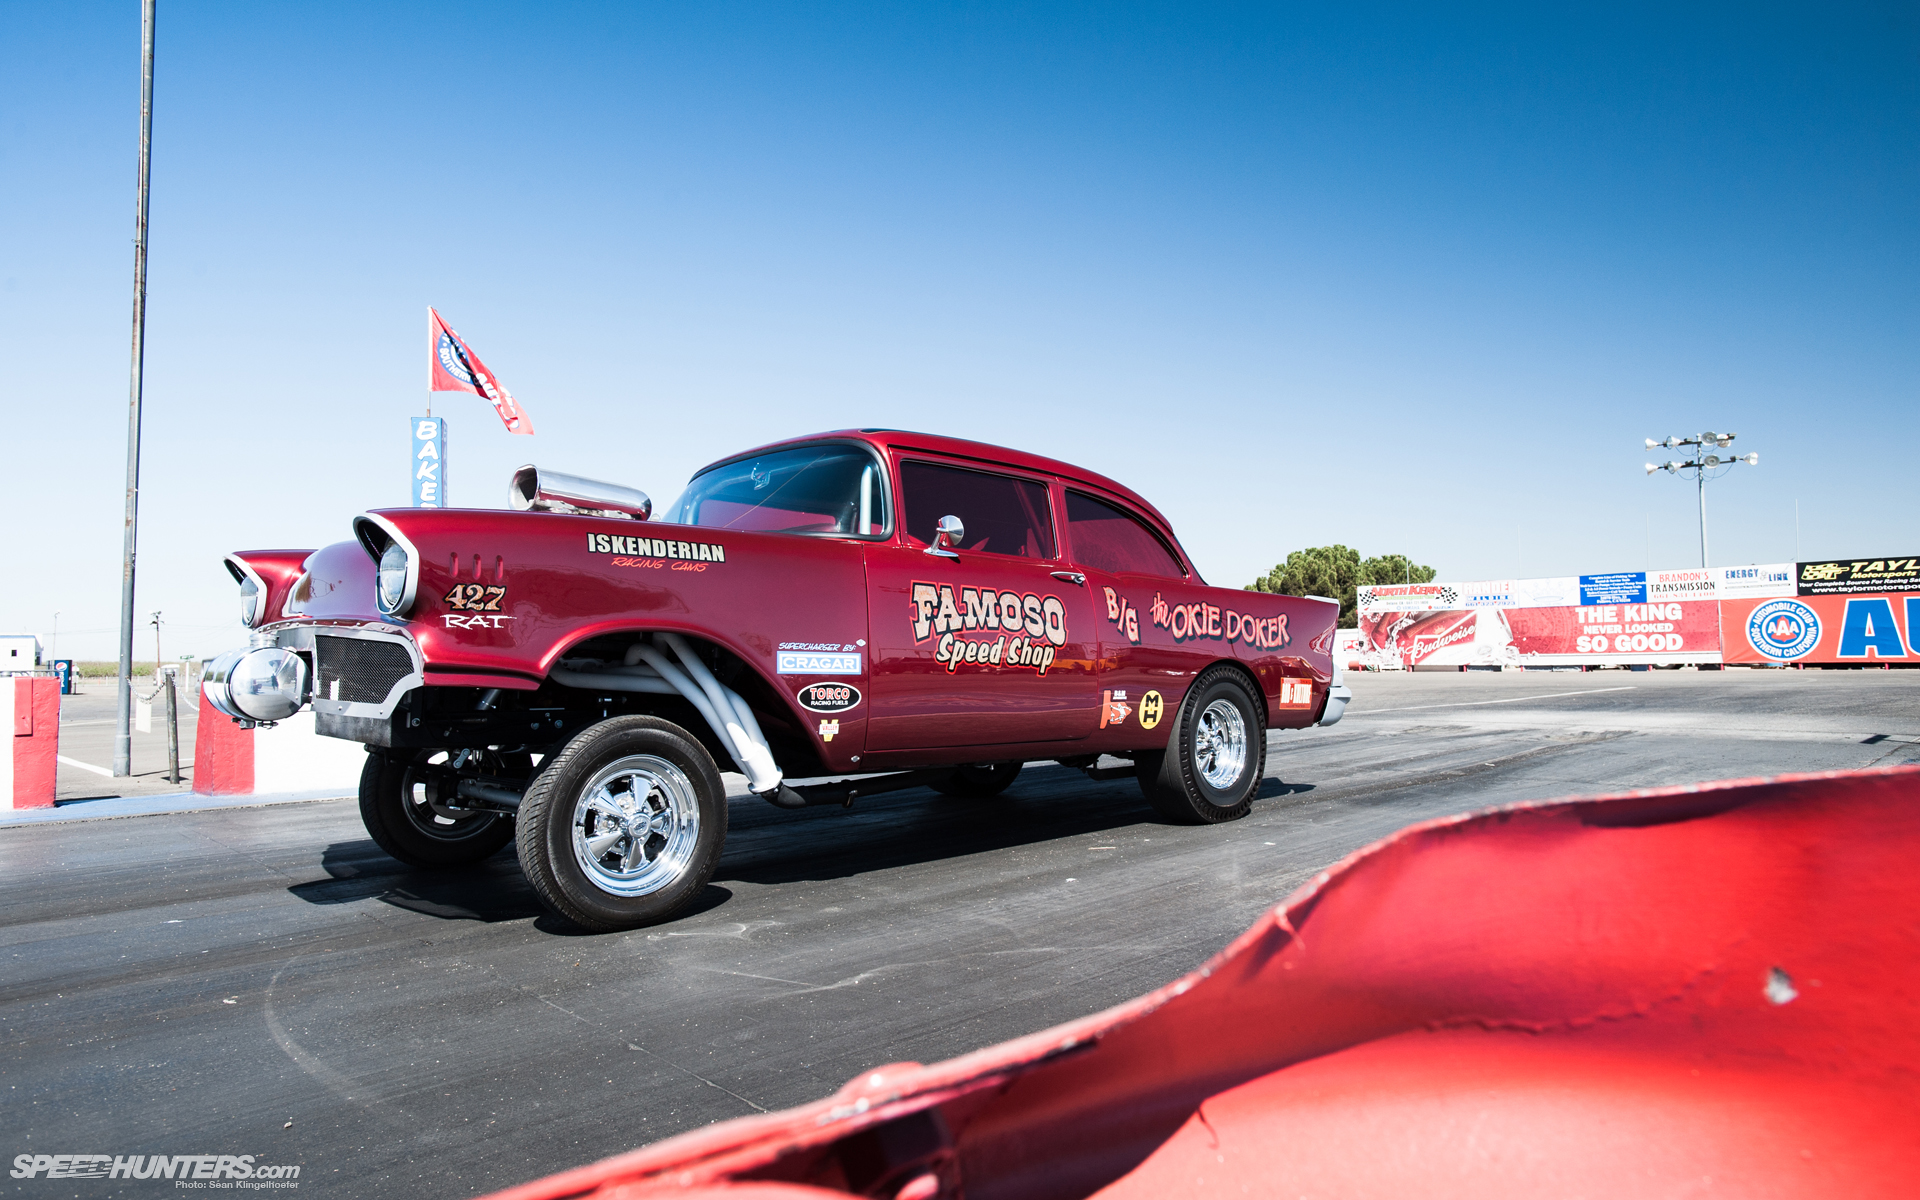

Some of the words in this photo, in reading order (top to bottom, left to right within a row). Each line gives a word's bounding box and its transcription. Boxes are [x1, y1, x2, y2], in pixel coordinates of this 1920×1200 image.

[416, 420, 439, 508] BAKE
[586, 533, 725, 562] ISKENDERIAN
[611, 556, 665, 570] RACING
[671, 560, 709, 573] CAMS
[1658, 572, 1709, 583] BRANDON'S
[1725, 569, 1759, 579] ENERGY
[1768, 572, 1789, 582] LINK
[1850, 571, 1917, 579] Motorsports
[1372, 586, 1408, 596] NORTH
[1408, 585, 1443, 595] KERN
[1650, 581, 1716, 593] TRANSMISSION
[445, 583, 507, 612] 427
[911, 582, 1067, 646] FAMOSO
[1149, 592, 1172, 628] the
[1226, 610, 1290, 648] DOKER
[1575, 606, 1618, 623] THE
[1624, 603, 1683, 622] KING
[1753, 602, 1797, 625] AUTOMOBILE
[1796, 606, 1815, 624] CLUB
[440, 614, 517, 630] RAT
[1584, 624, 1622, 634] NEVER
[1625, 622, 1674, 633] LOOKED
[1767, 620, 1799, 636] AAA
[1405, 625, 1477, 660] Budweise
[1576, 636, 1609, 652] SO
[1614, 633, 1684, 652] GOOD
[1751, 627, 1783, 657] SOUTHERN
[1783, 626, 1817, 657] CALIFORNIA
[936, 632, 1007, 673] Speed
[1006, 636, 1056, 676] Shop
[783, 657, 855, 669] CRAGAR
[809, 687, 850, 700] TORCO
